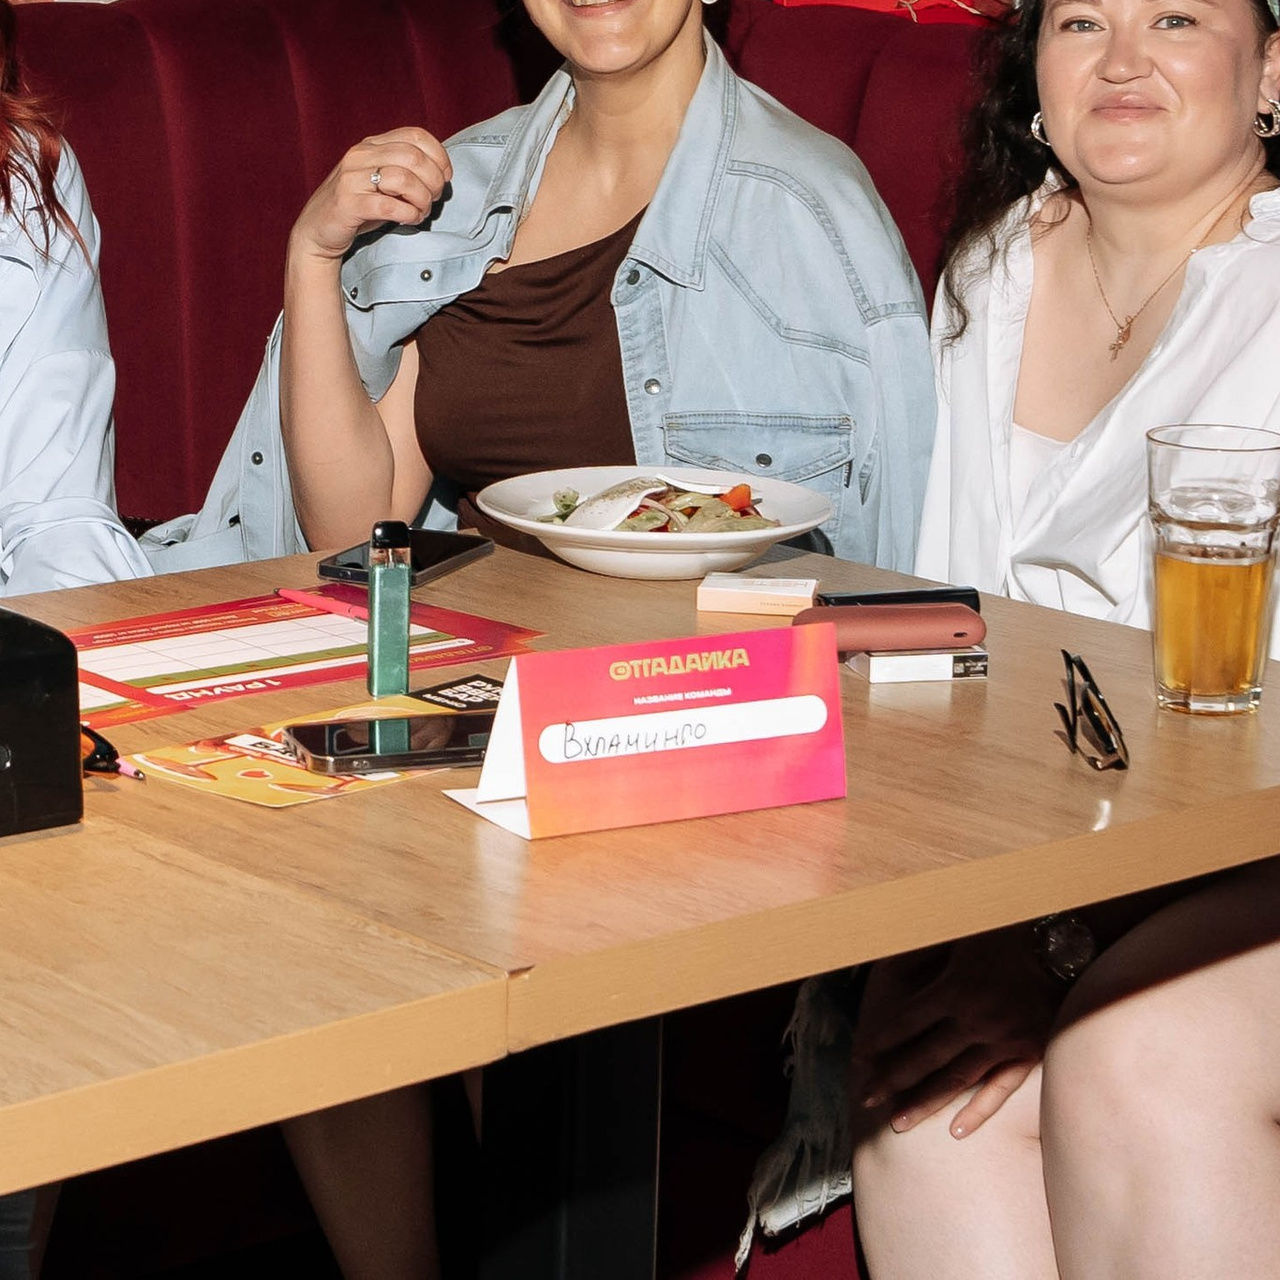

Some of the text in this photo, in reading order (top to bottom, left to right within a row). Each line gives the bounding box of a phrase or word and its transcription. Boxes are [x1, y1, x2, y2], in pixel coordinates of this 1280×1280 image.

[164, 681, 267, 701] РАУНД
[633, 687, 732, 706] НАЗВАНИЕ КОМАНДЫ
